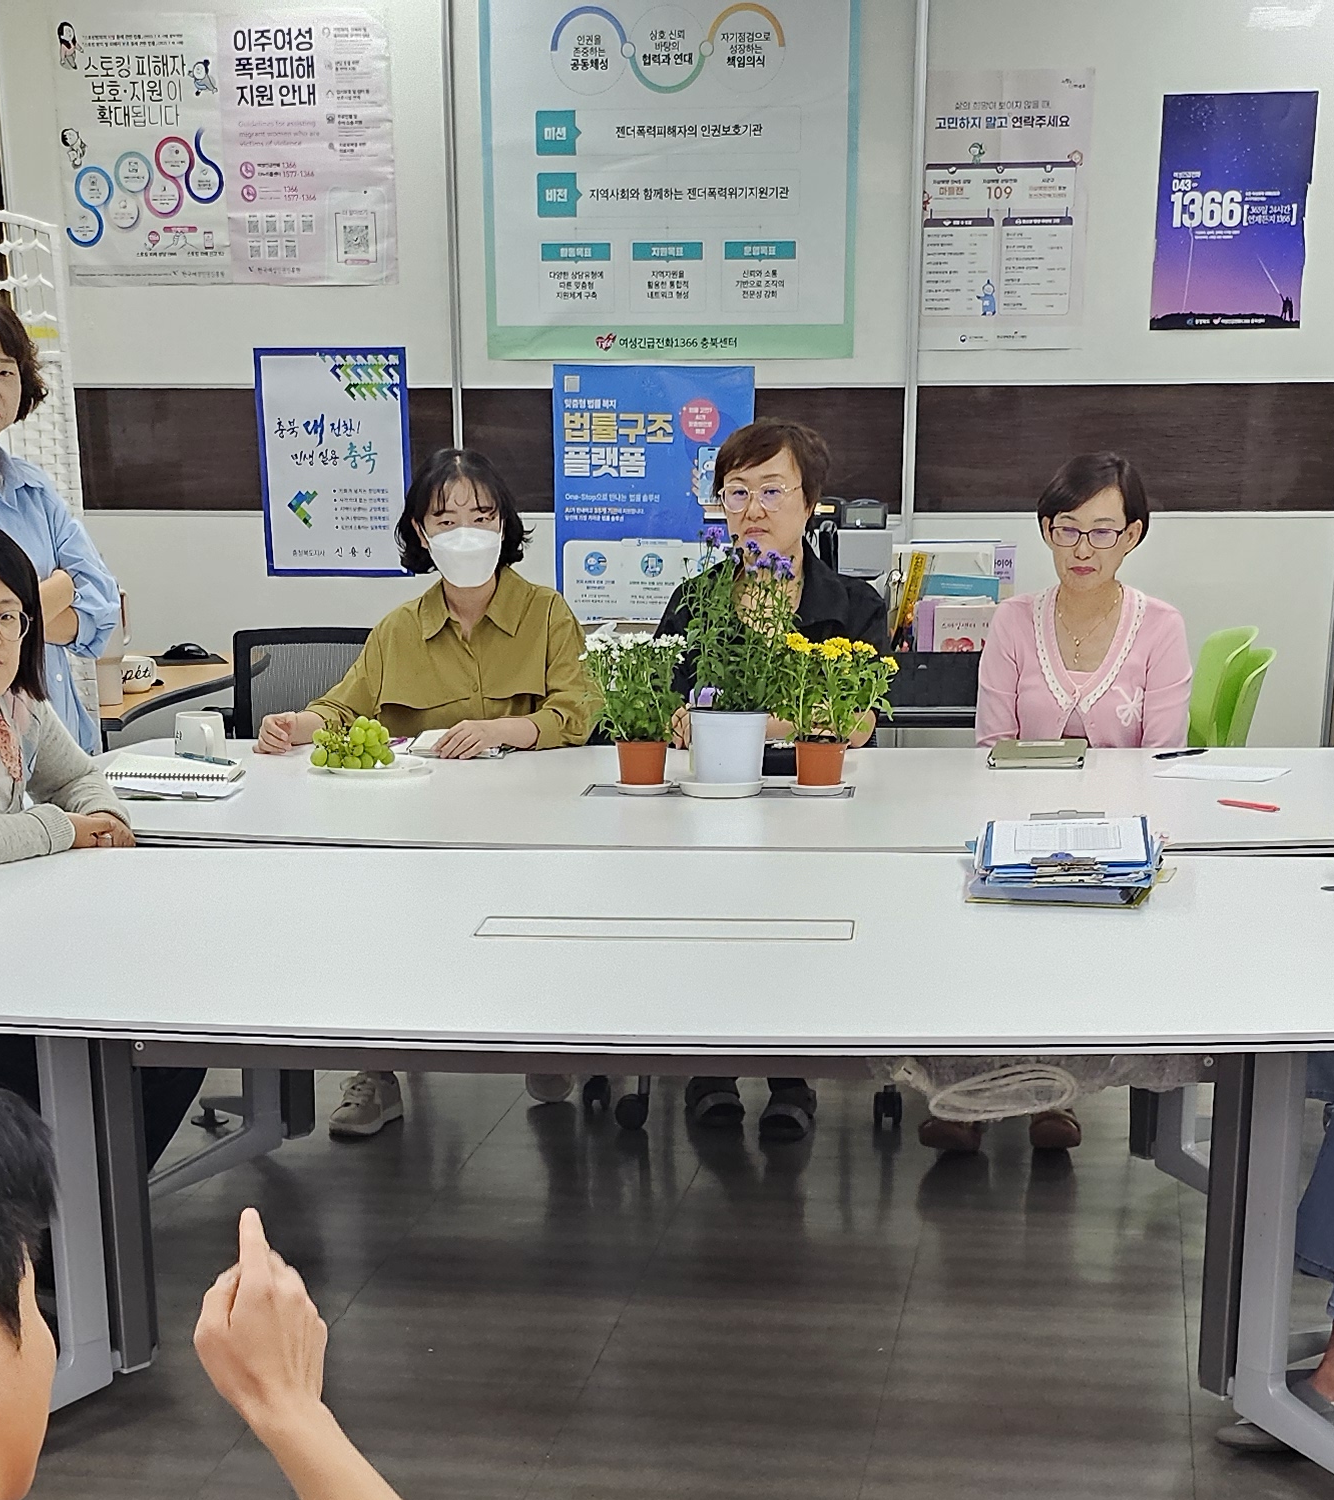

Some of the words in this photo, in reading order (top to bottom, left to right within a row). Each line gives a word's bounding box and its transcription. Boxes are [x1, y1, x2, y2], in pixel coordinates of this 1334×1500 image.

[233, 27, 314, 52] 이주여성
[576, 35, 602, 46] 인권을
[669, 29, 685, 40] 신뢰
[721, 31, 771, 42] 자기점검으로
[573, 46, 605, 57] 존중하는
[729, 43, 763, 54] 성장하는
[84, 55, 131, 78] 스토킹
[135, 54, 186, 77] 피해자
[570, 58, 609, 71] 공동체성
[642, 53, 671, 66] 협력과
[673, 52, 693, 65] 연대
[726, 55, 766, 68] 책임의식
[235, 55, 315, 80] 폭력피해
[236, 84, 274, 107] 지원
[278, 83, 316, 106] 안내
[97, 105, 180, 127] 확대됩니다
[935, 116, 982, 130] 고민하지
[985, 116, 1008, 129] 말고
[1012, 115, 1070, 129] 연락주세요
[615, 125, 698, 139] 젠더폭력피해자의
[701, 123, 763, 138] 인권보호기관
[987, 186, 1013, 199] 109
[1172, 179, 1192, 191] 043
[545, 187, 568, 203] 비전
[589, 187, 641, 201] 지역사회와
[643, 187, 684, 201] 함께하는
[687, 186, 790, 200] 젠더폭력위기지원기관
[1171, 190, 1243, 228] 1366
[619, 337, 698, 349] 여성긴급전화1366
[700, 337, 738, 349] 충북센터
[587, 399, 602, 408] 법률
[274, 417, 299, 439] 충북
[303, 413, 325, 447] 대
[564, 412, 674, 444] 법률구조
[291, 449, 315, 466] 민생
[318, 449, 340, 466] 실용
[343, 441, 378, 475] 충북
[564, 446, 646, 477] 플랫폼
